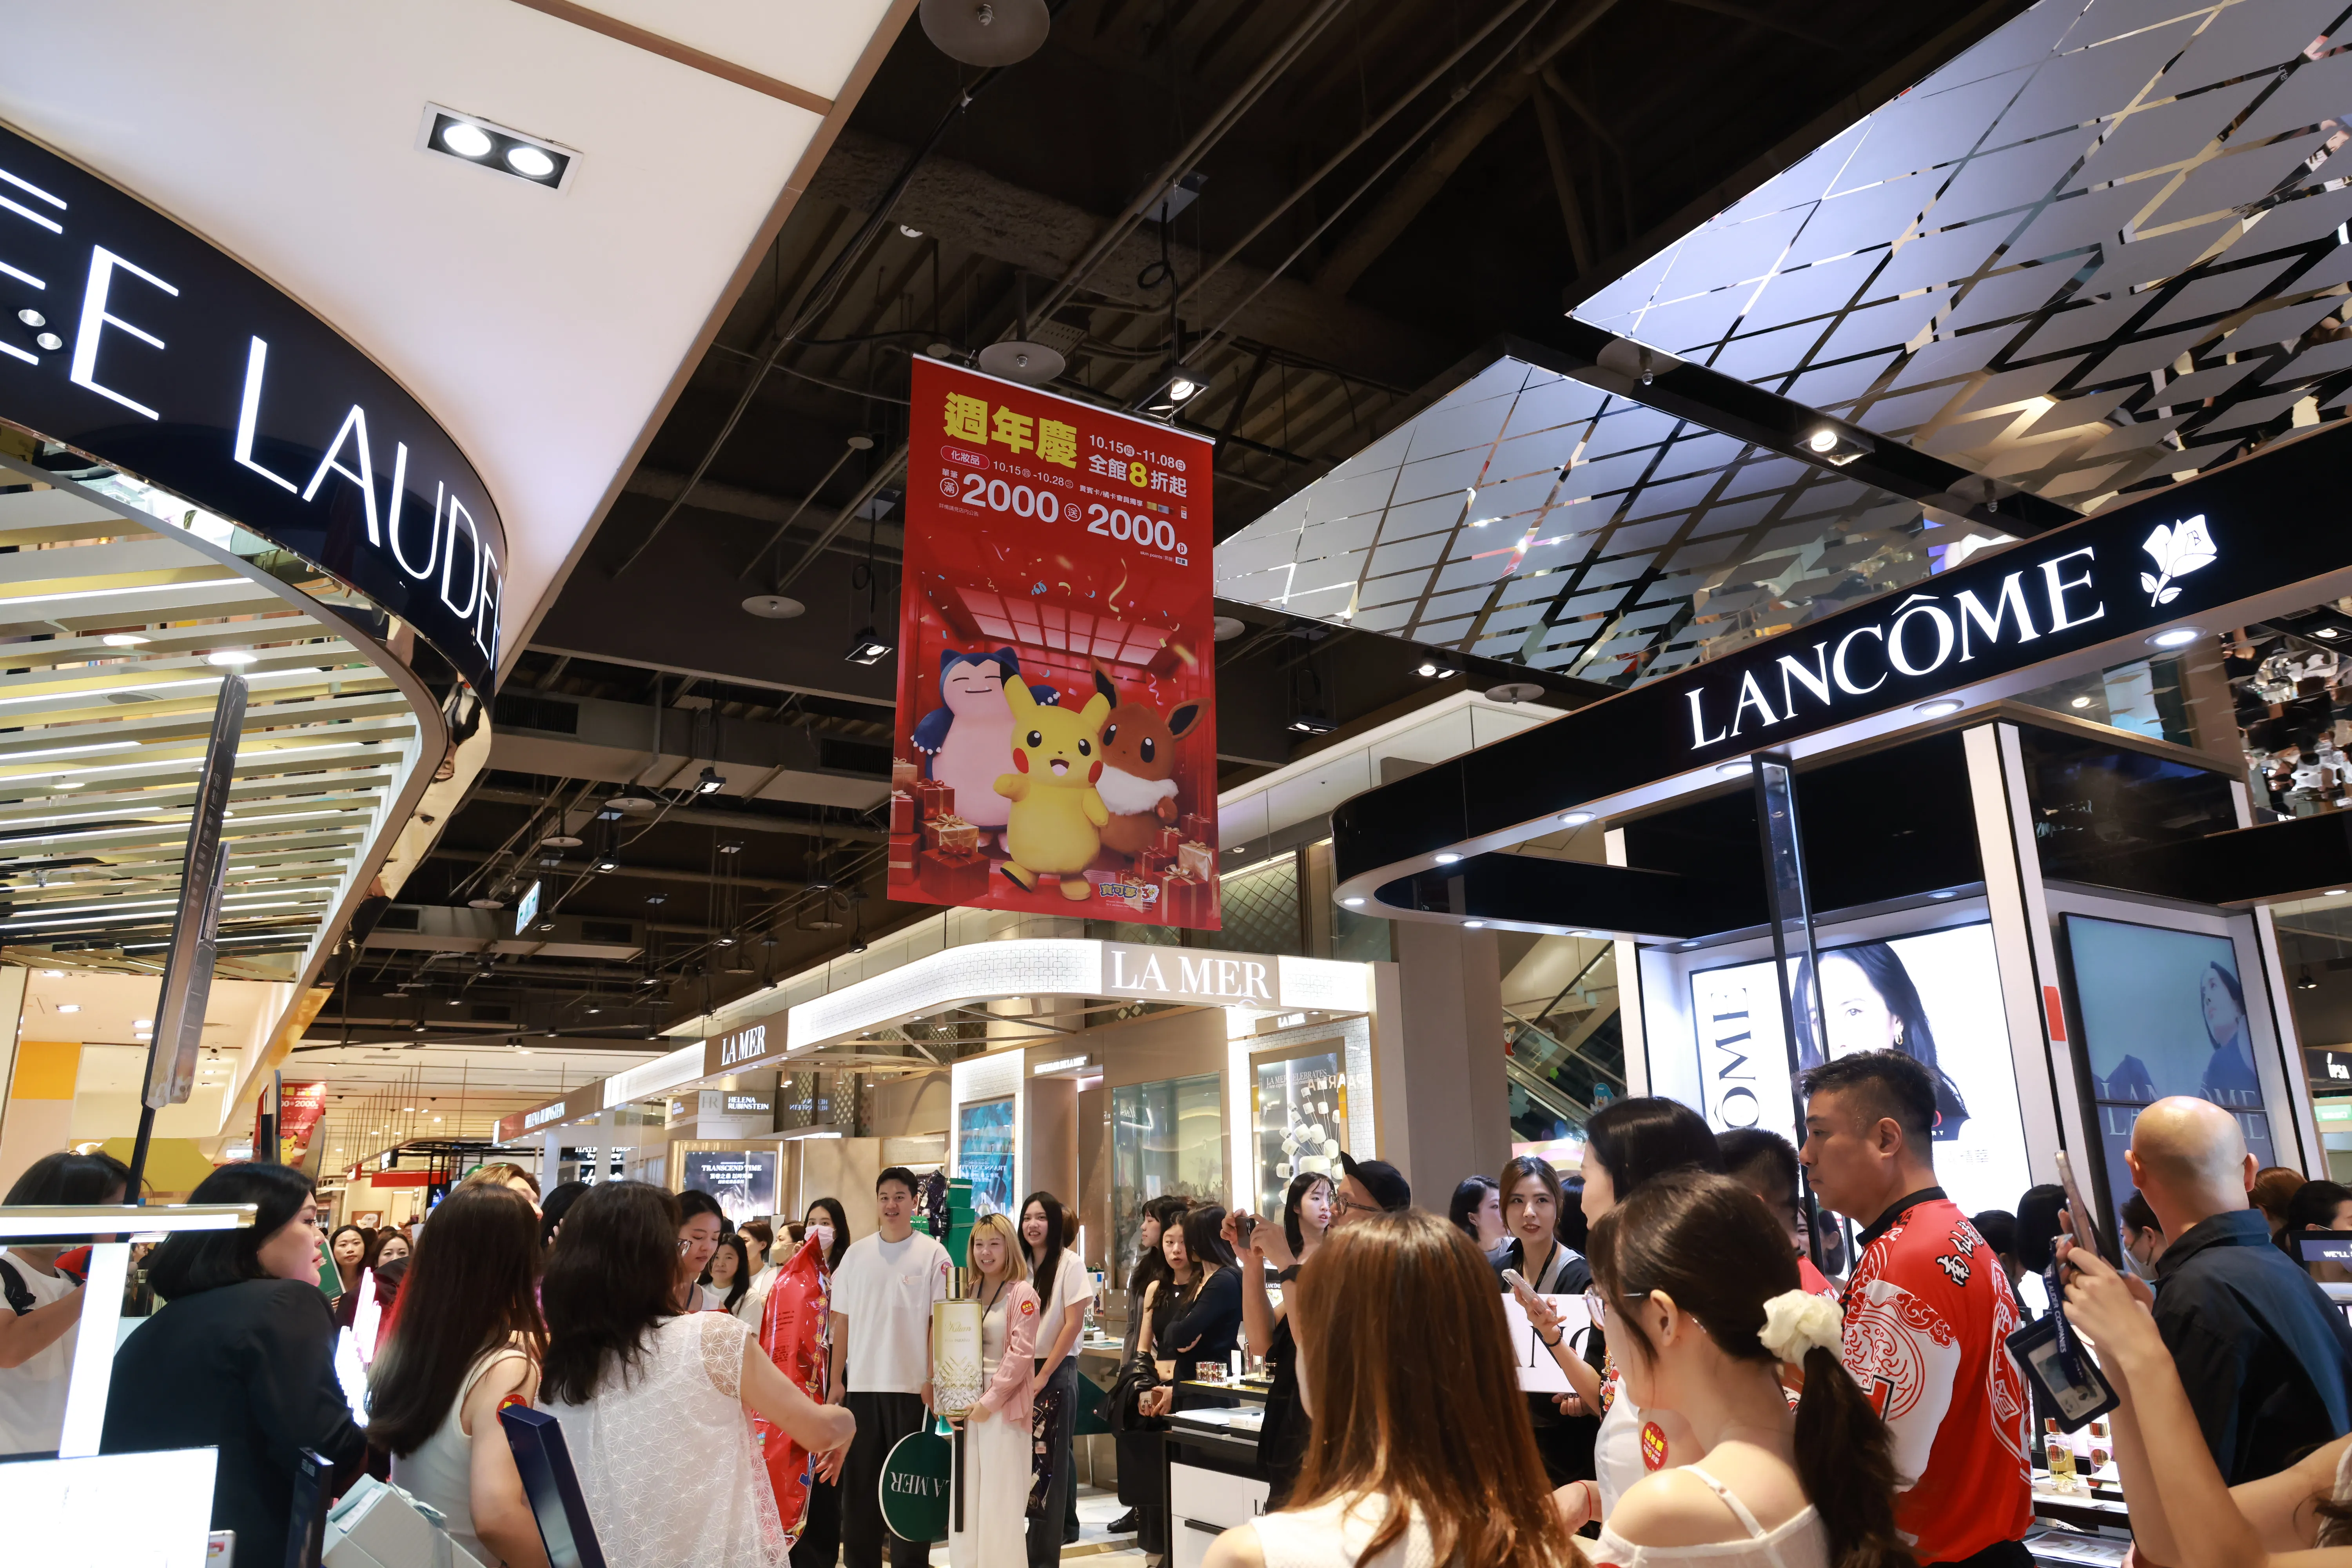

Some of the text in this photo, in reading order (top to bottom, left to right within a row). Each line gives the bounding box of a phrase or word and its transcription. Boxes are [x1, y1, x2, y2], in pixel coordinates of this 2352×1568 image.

[943, 392, 1077, 469] 週年慶
[942, 468, 958, 478] 單筆
[951, 450, 980, 466] 化妝品
[1089, 454, 1187, 497] 全館8折起
[942, 479, 956, 495] 滿
[962, 473, 1059, 523] 2000
[1066, 505, 1079, 520] 送
[1087, 504, 1175, 551] 2000
[1684, 546, 2105, 750] LANCÔME
[1100, 884, 1137, 898] 寶可夢
[1111, 951, 1272, 999] LA MER
[1278, 1013, 1305, 1028] LA MER
[721, 1025, 766, 1066] LA MER
[1267, 1077, 1274, 1085] LA
[1293, 1069, 1327, 1082] ELEBRATES
[524, 1111, 540, 1129] HELENA
[2046, 1281, 2059, 1308] LAUDER
[2054, 1310, 2067, 1353] COMPANIES
[891, 1472, 929, 1496] MER
